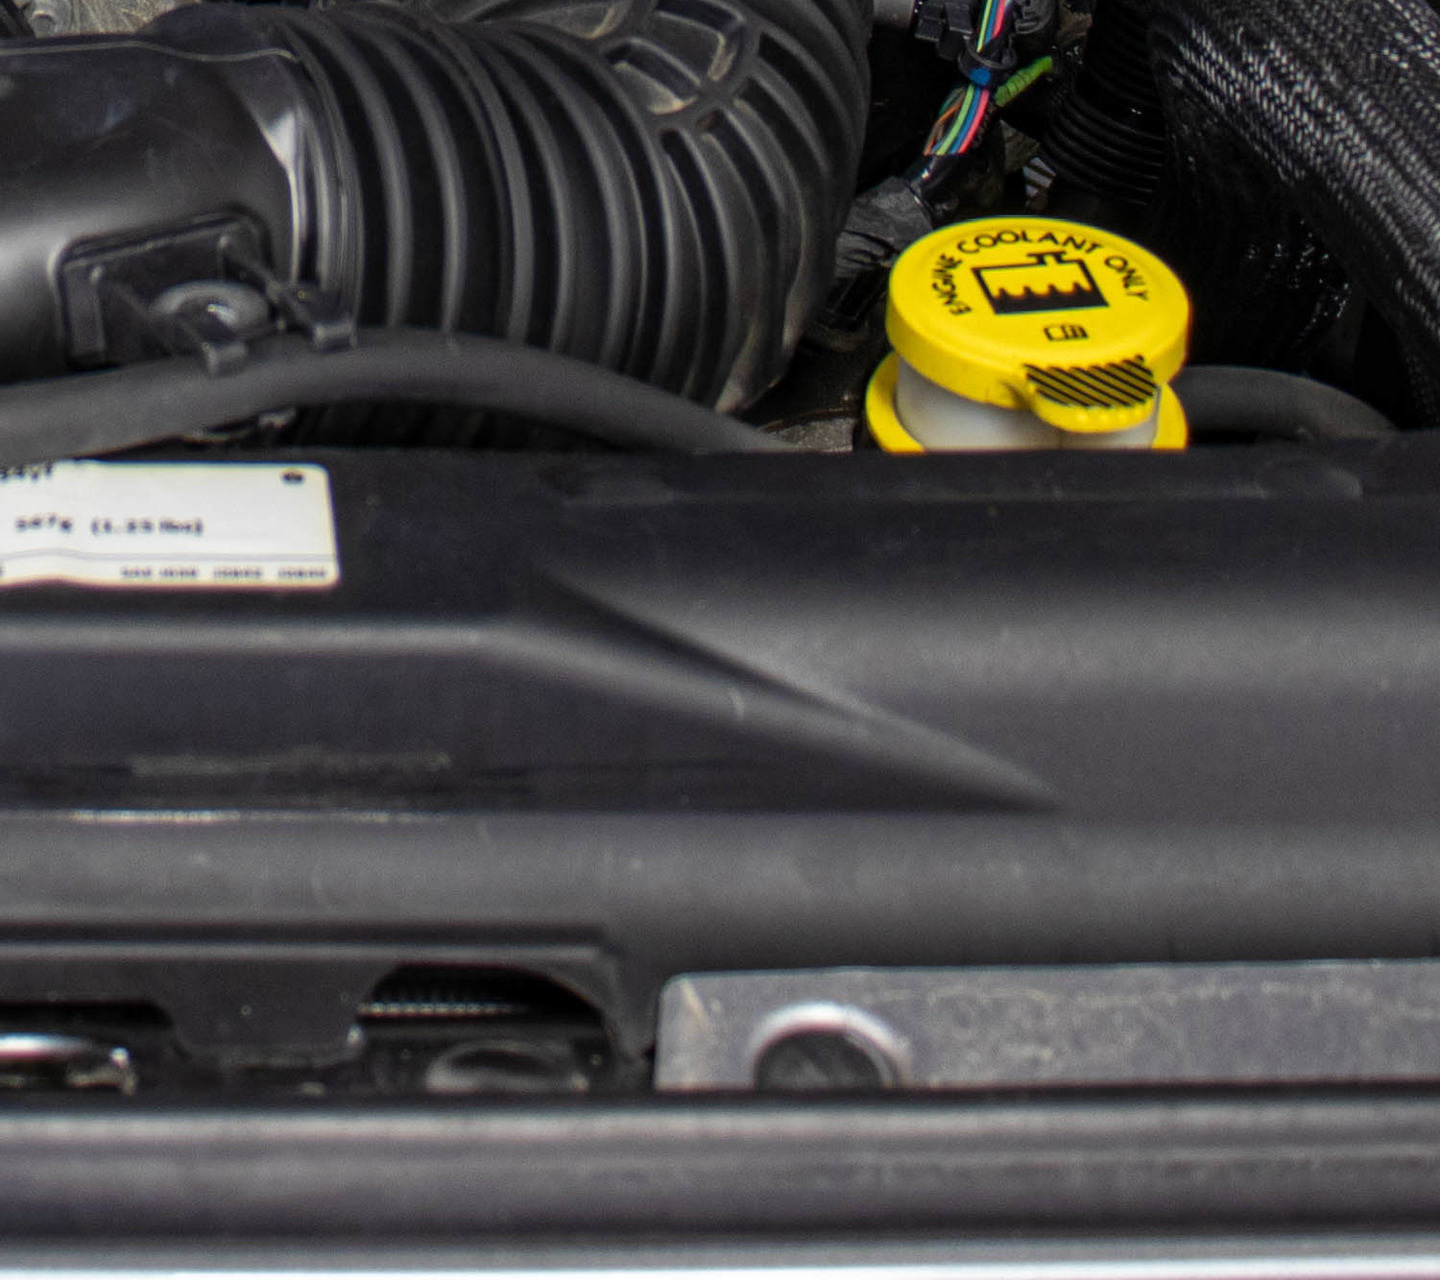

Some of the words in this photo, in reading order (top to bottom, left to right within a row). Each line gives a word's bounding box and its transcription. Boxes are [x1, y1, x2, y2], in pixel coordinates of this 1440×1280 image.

[931, 252, 973, 316] ENGINE
[957, 229, 1104, 255] COOLANT
[1104, 254, 1149, 301] ONLY
